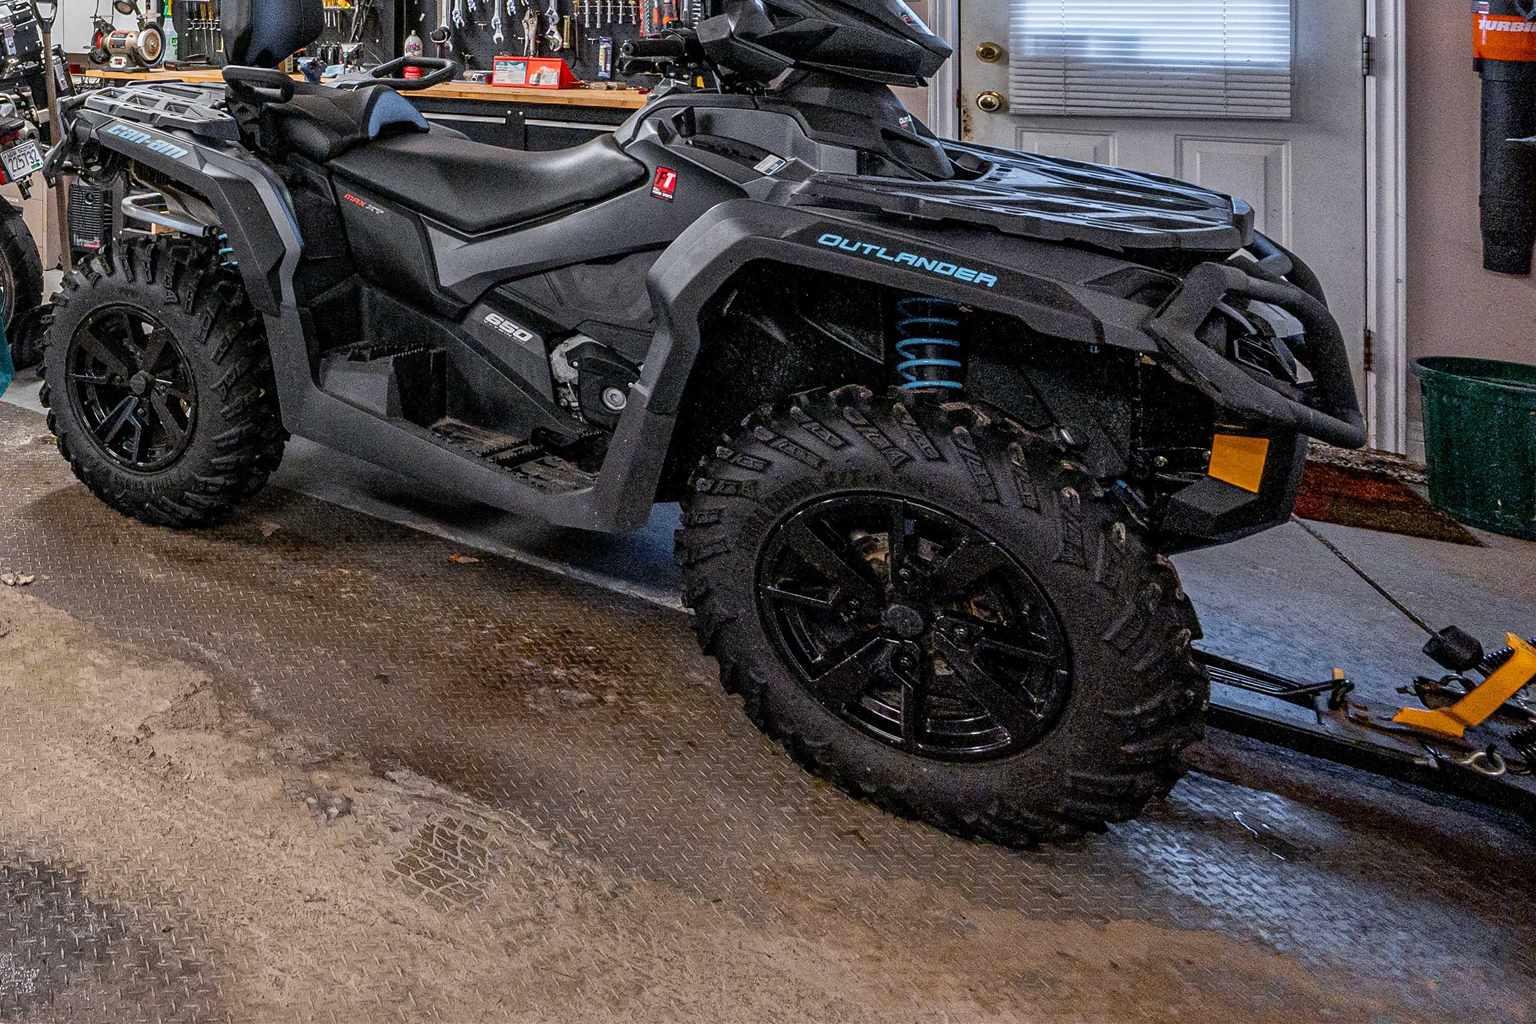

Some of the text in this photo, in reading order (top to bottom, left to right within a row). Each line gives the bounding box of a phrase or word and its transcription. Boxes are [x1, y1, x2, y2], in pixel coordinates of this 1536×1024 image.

[8, 148, 41, 172] 225732
[817, 233, 999, 288] OUTLANDER
[484, 313, 533, 342] 650
